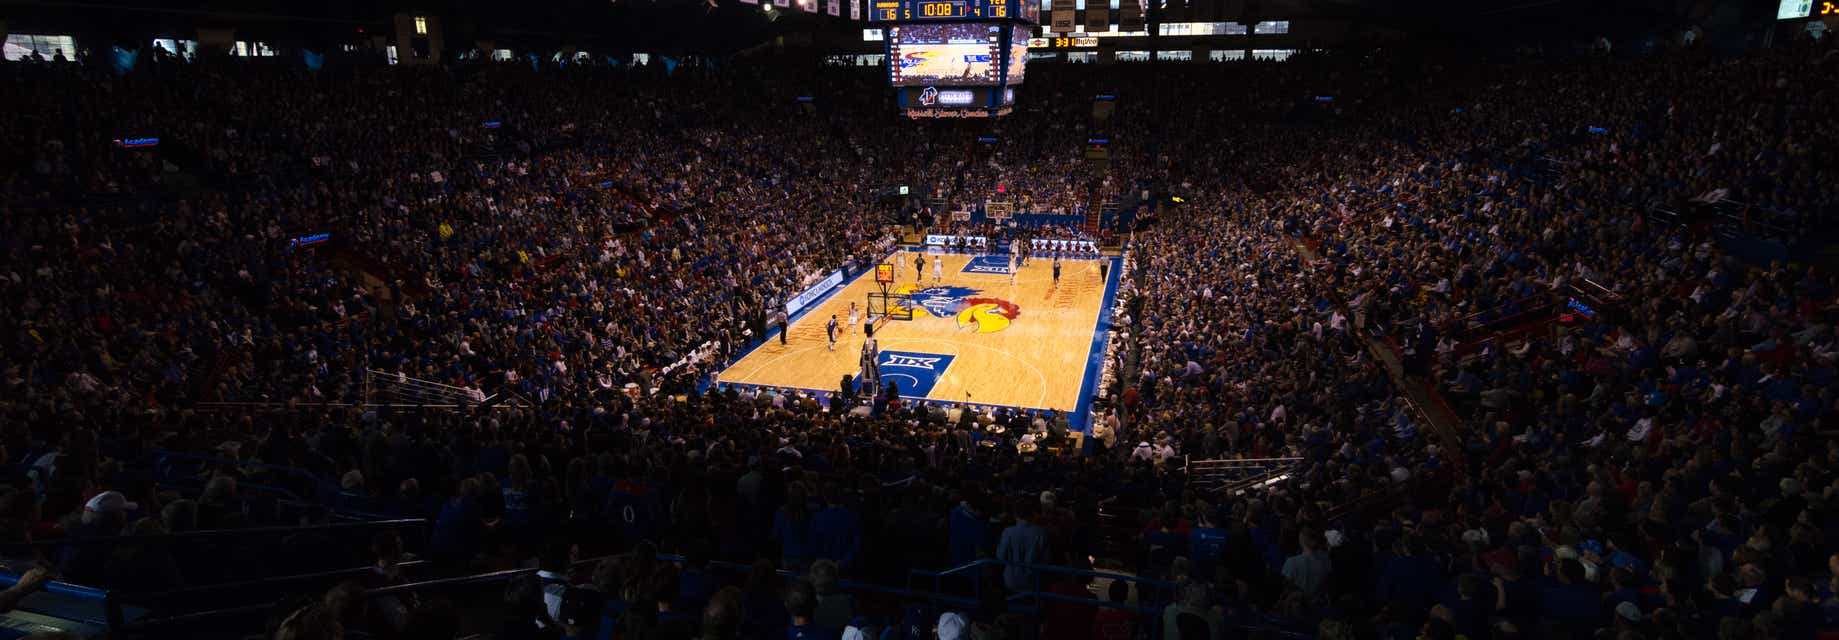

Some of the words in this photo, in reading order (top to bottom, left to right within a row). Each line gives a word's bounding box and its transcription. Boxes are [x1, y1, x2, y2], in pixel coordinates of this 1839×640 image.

[887, 9, 897, 20] 16
[905, 10, 910, 19] 5
[924, 3, 951, 16] 10:08
[974, 8, 980, 16] 4
[995, 6, 1006, 17] 16
[1056, 38, 1075, 47] 3:31
